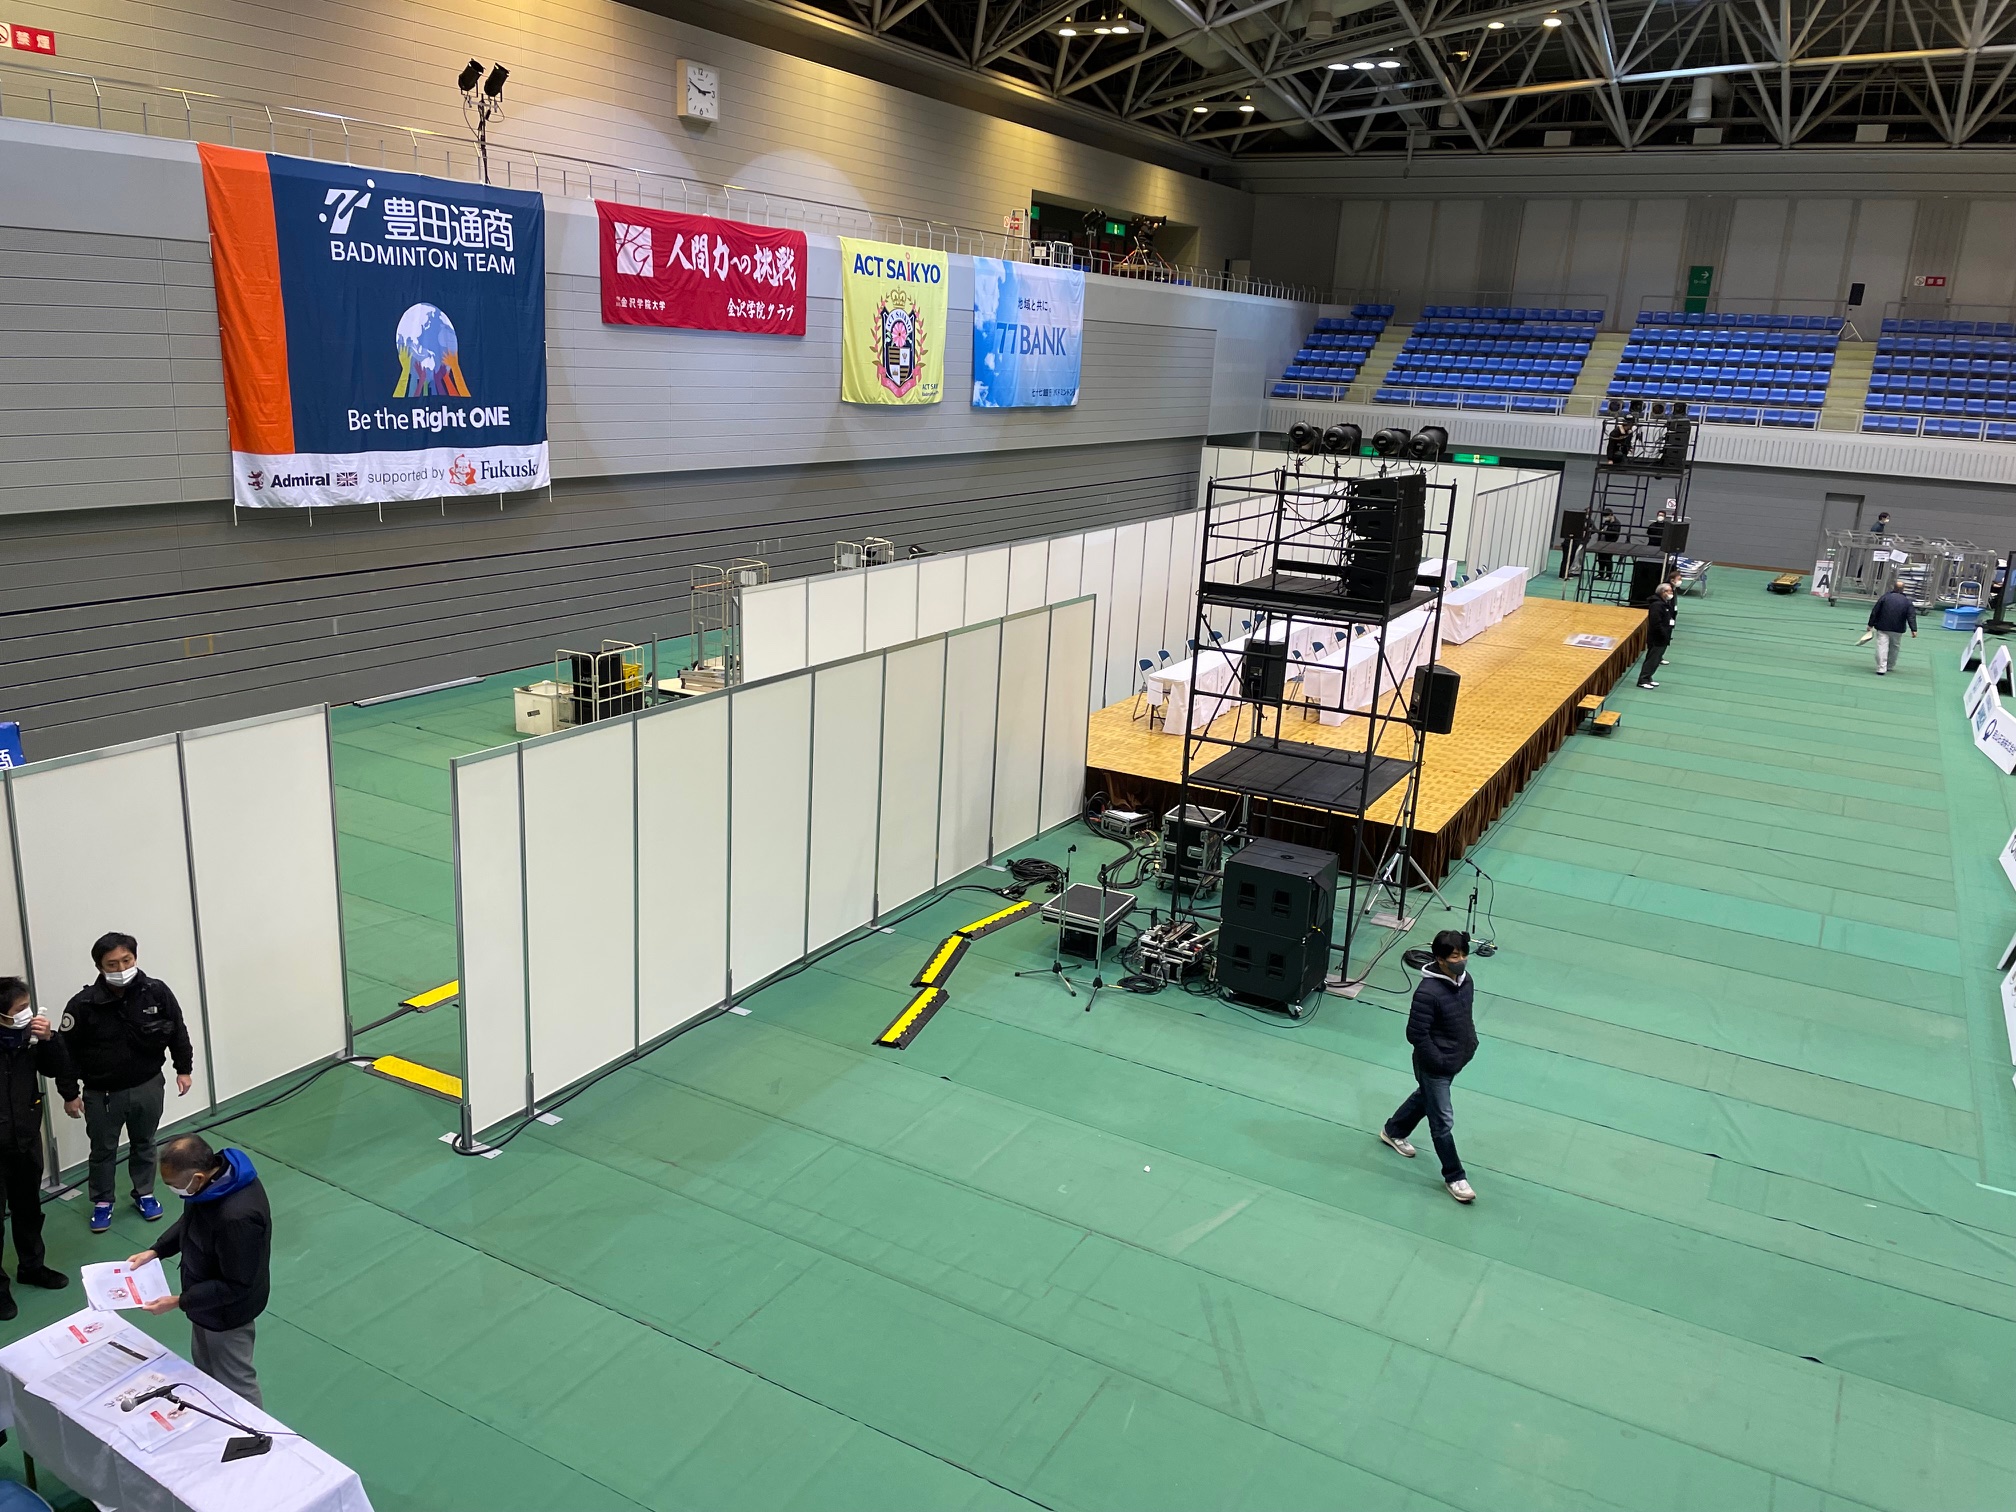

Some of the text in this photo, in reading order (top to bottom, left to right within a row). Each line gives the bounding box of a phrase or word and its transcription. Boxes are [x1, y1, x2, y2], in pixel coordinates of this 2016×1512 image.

[383, 197, 514, 251] 豊田通商
[330, 241, 516, 275] BADMINTON TEAM
[666, 232, 797, 291] 人間力への挑戦
[853, 253, 884, 278] ACT
[620, 296, 666, 311] 金沢学院大学
[727, 297, 795, 322] 金沢学院クラブ
[348, 405, 511, 433] Be the Right ONE
[270, 472, 331, 488] Admiral
[368, 467, 445, 485] supported by
[480, 459, 539, 480] Fukusk
[1816, 574, 1830, 589] A
